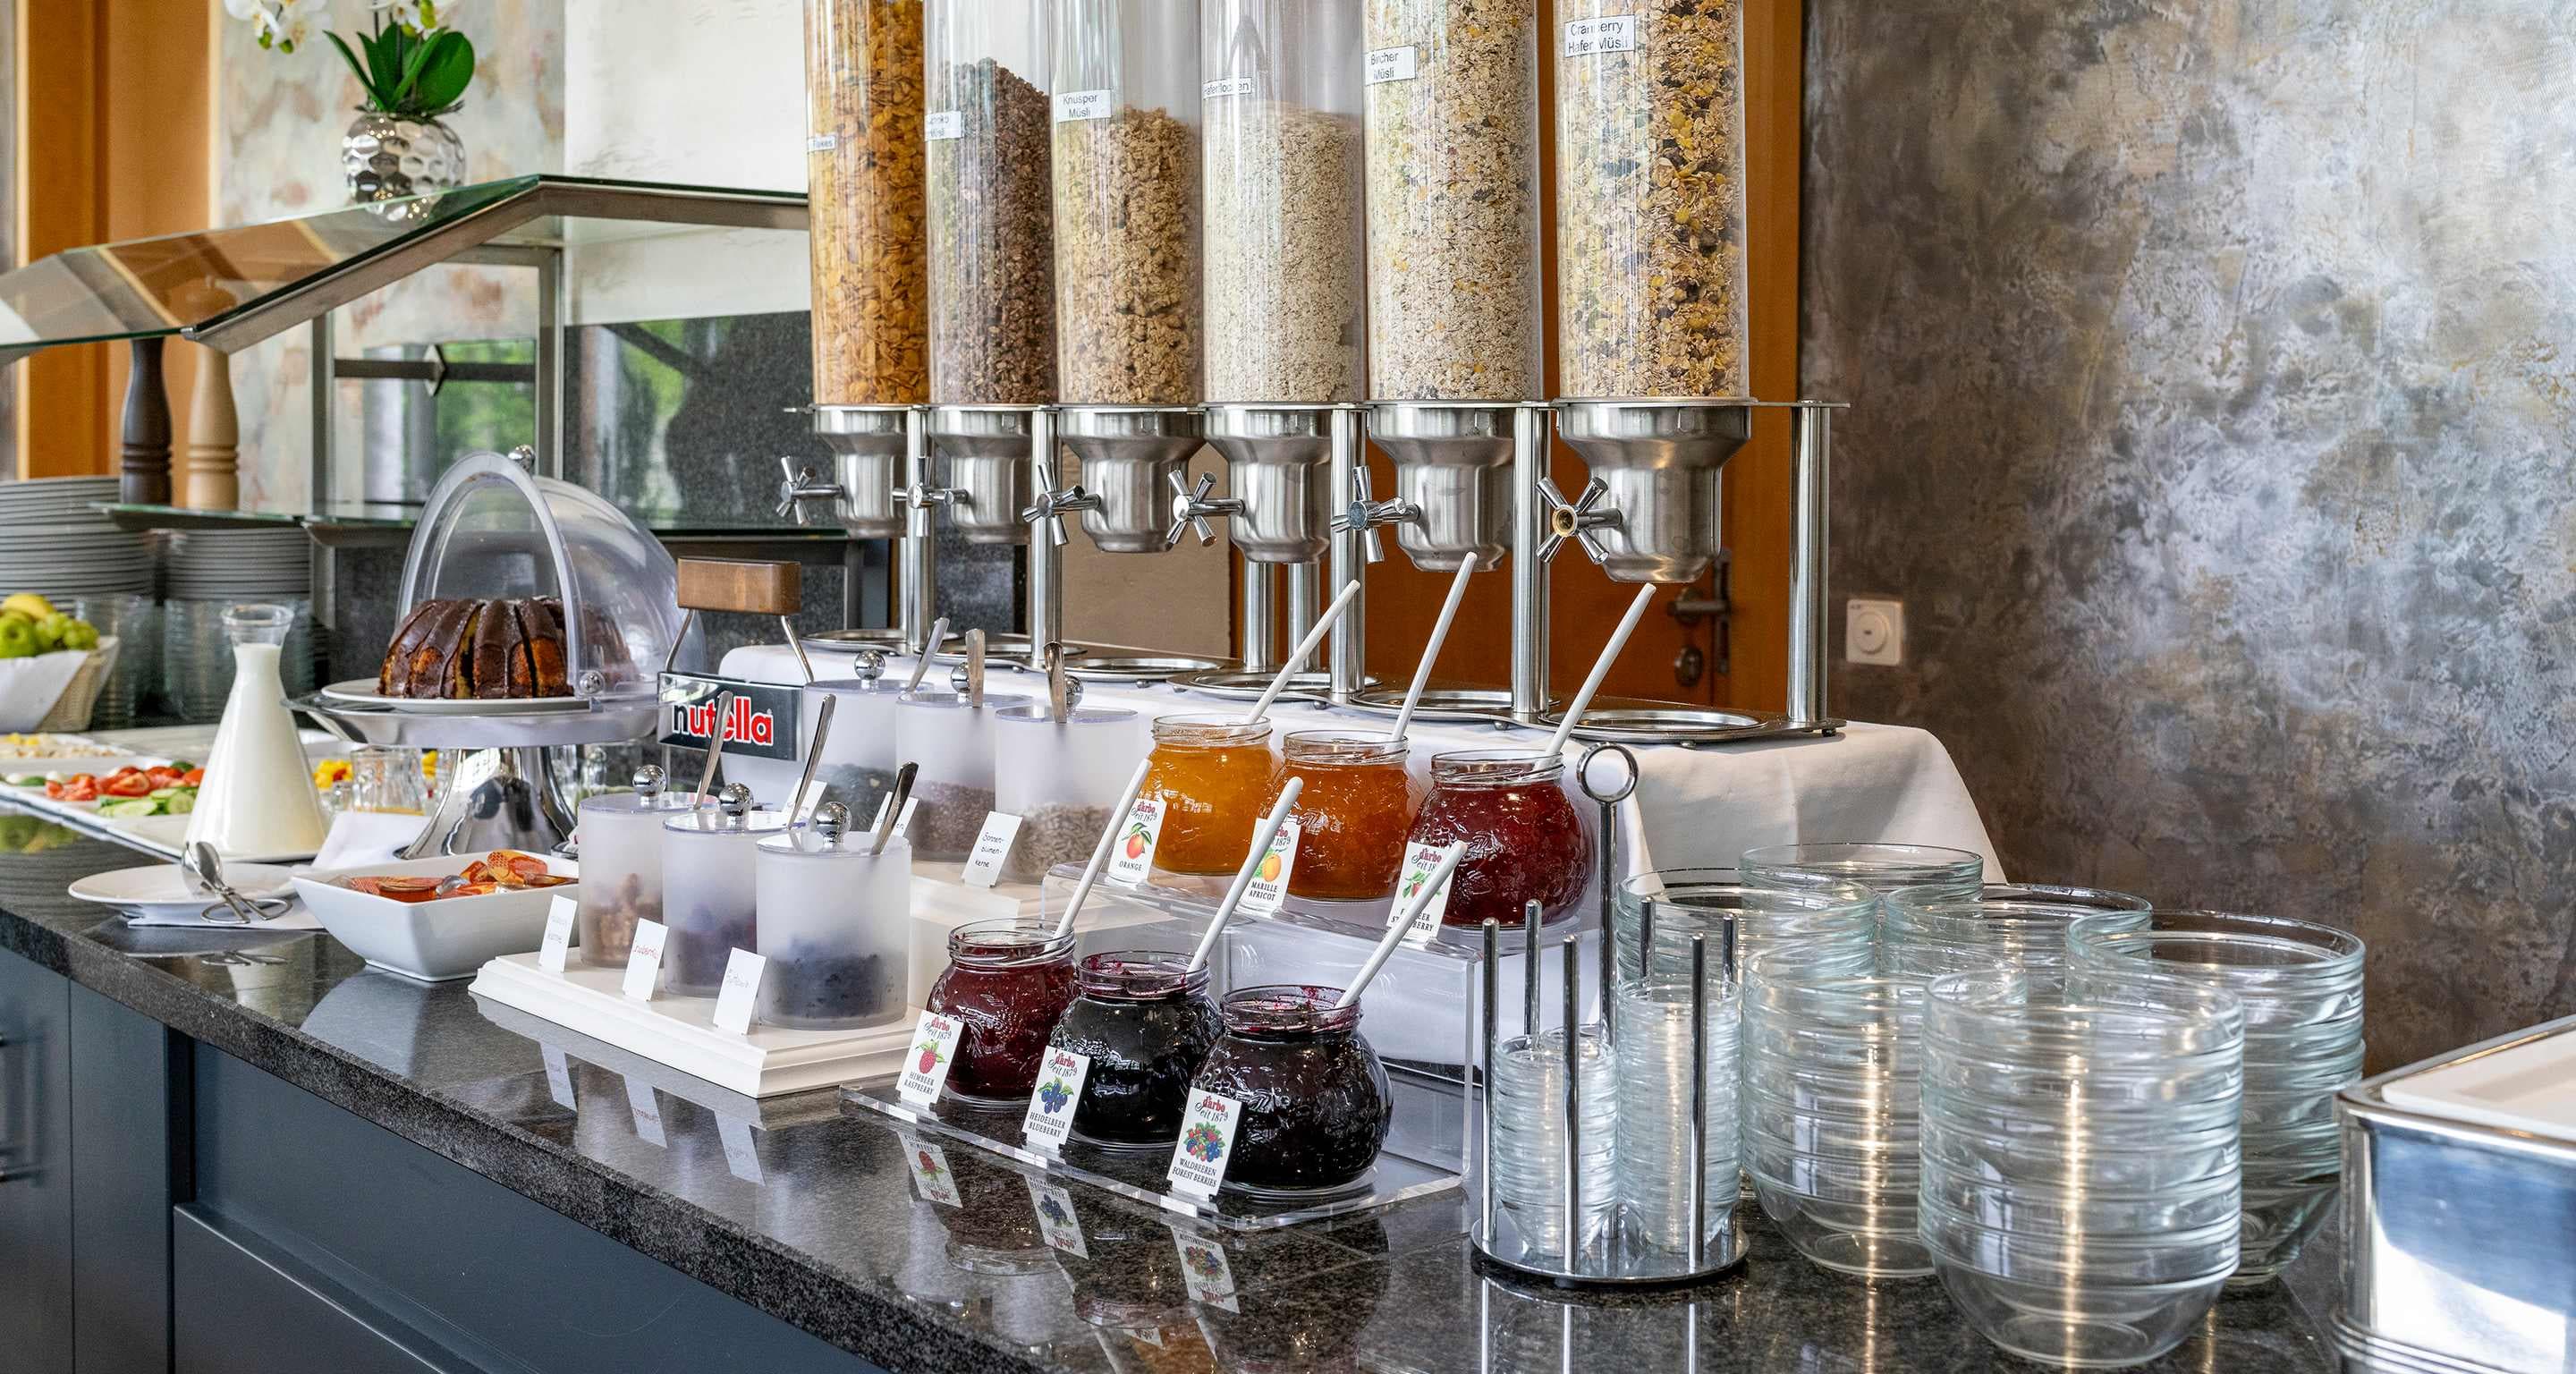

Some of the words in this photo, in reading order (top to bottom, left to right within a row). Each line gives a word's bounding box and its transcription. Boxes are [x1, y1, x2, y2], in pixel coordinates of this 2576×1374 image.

[1568, 39, 1594, 54] Hafer
[1063, 93, 1097, 106] Knusper
[673, 696, 774, 746] nutella
[1119, 861, 1142, 872] ORANGE
[1251, 881, 1278, 893] MARILLE
[1249, 889, 1276, 901] APRICOT
[1391, 915, 1434, 931] STBERRY
[909, 1072, 935, 1086] HIMBEER
[903, 1079, 935, 1095] RASPBERRY
[1030, 1112, 1065, 1129] HEIDELBEER
[1210, 1111, 1229, 1123] 1879
[1028, 1122, 1063, 1138] BLUEBERRY
[1179, 1158, 1217, 1176] WALDBEEREN
[1172, 1166, 1193, 1181] FOREST
[1192, 1171, 1216, 1188] BERRIES
